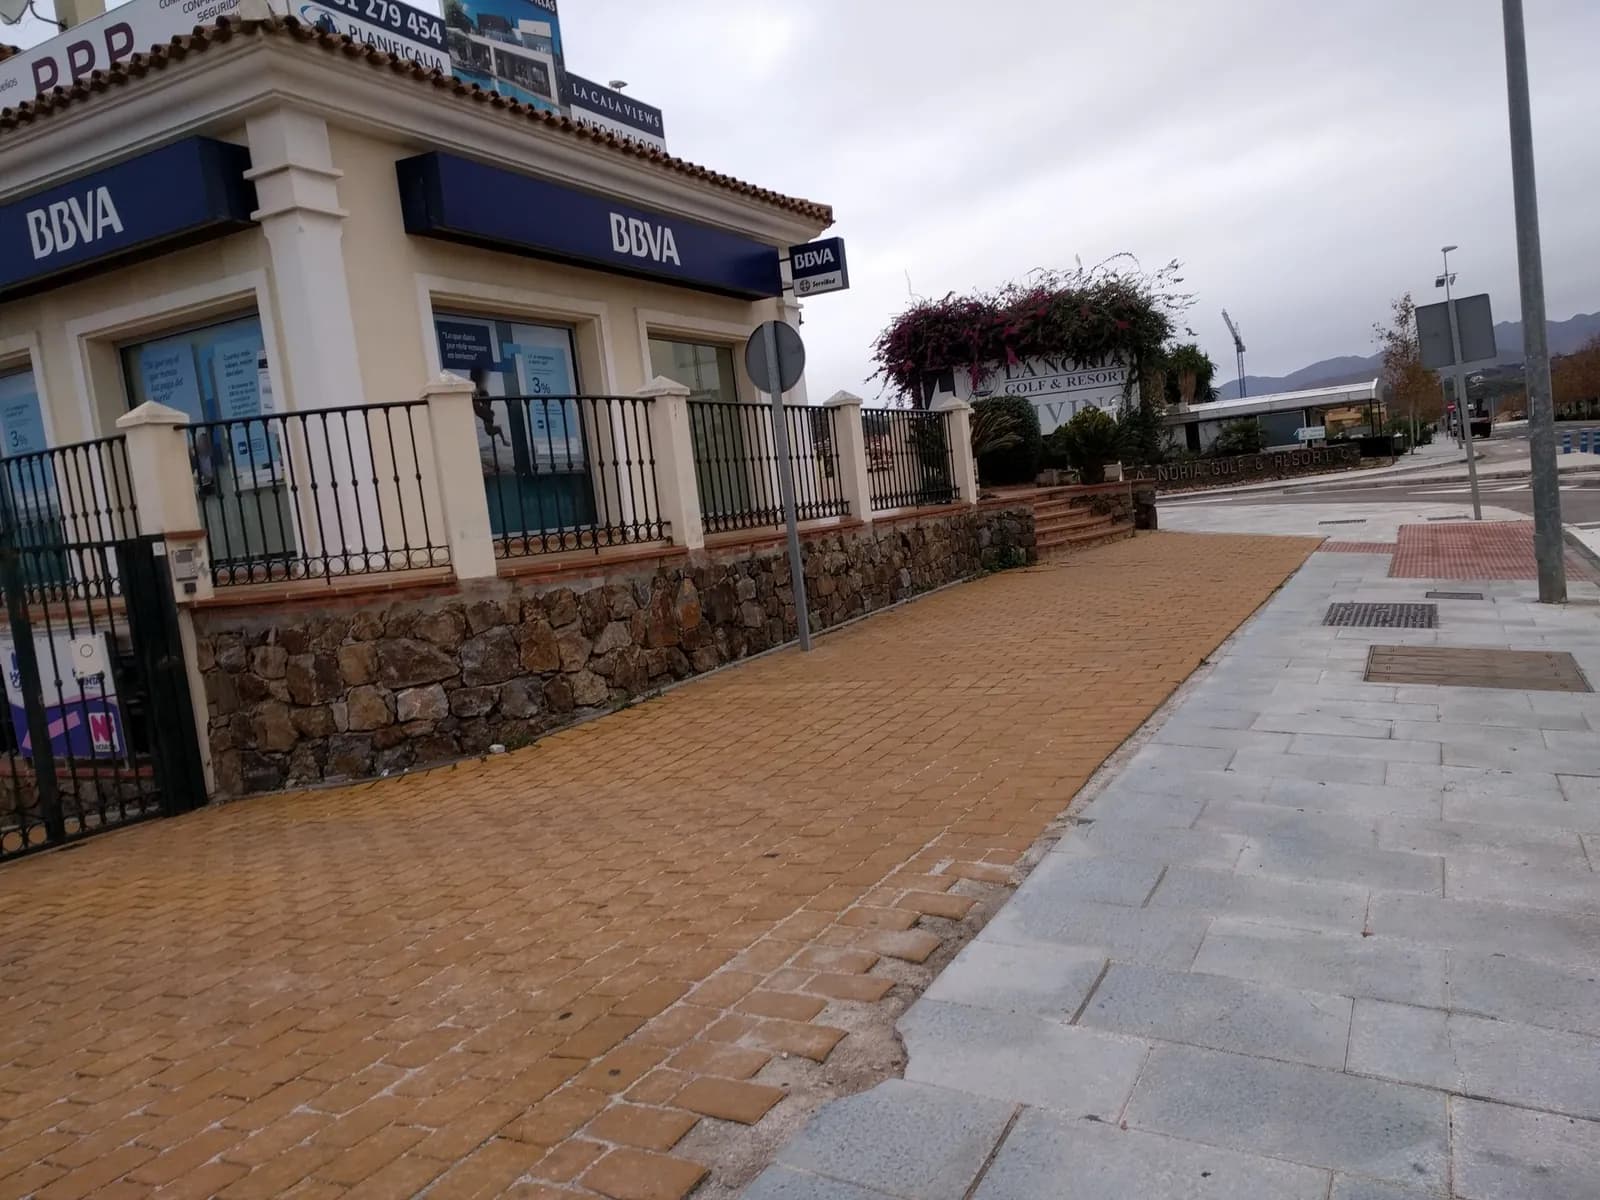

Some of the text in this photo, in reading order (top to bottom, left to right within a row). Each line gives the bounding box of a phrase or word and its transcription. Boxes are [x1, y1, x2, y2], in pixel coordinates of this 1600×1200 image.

[365, 0, 401, 28] 279
[407, 12, 442, 44] 454
[348, 24, 444, 73] PLANIFICALIA
[573, 83, 660, 127] LA CALA VIEWS
[26, 186, 124, 260] BBVA
[609, 212, 680, 266] BBVA
[794, 247, 835, 270] BBVA
[1005, 369, 1127, 395] GOLF & RESORT
[1158, 462, 1202, 481] NORIA
[1211, 458, 1244, 475] GOLF
